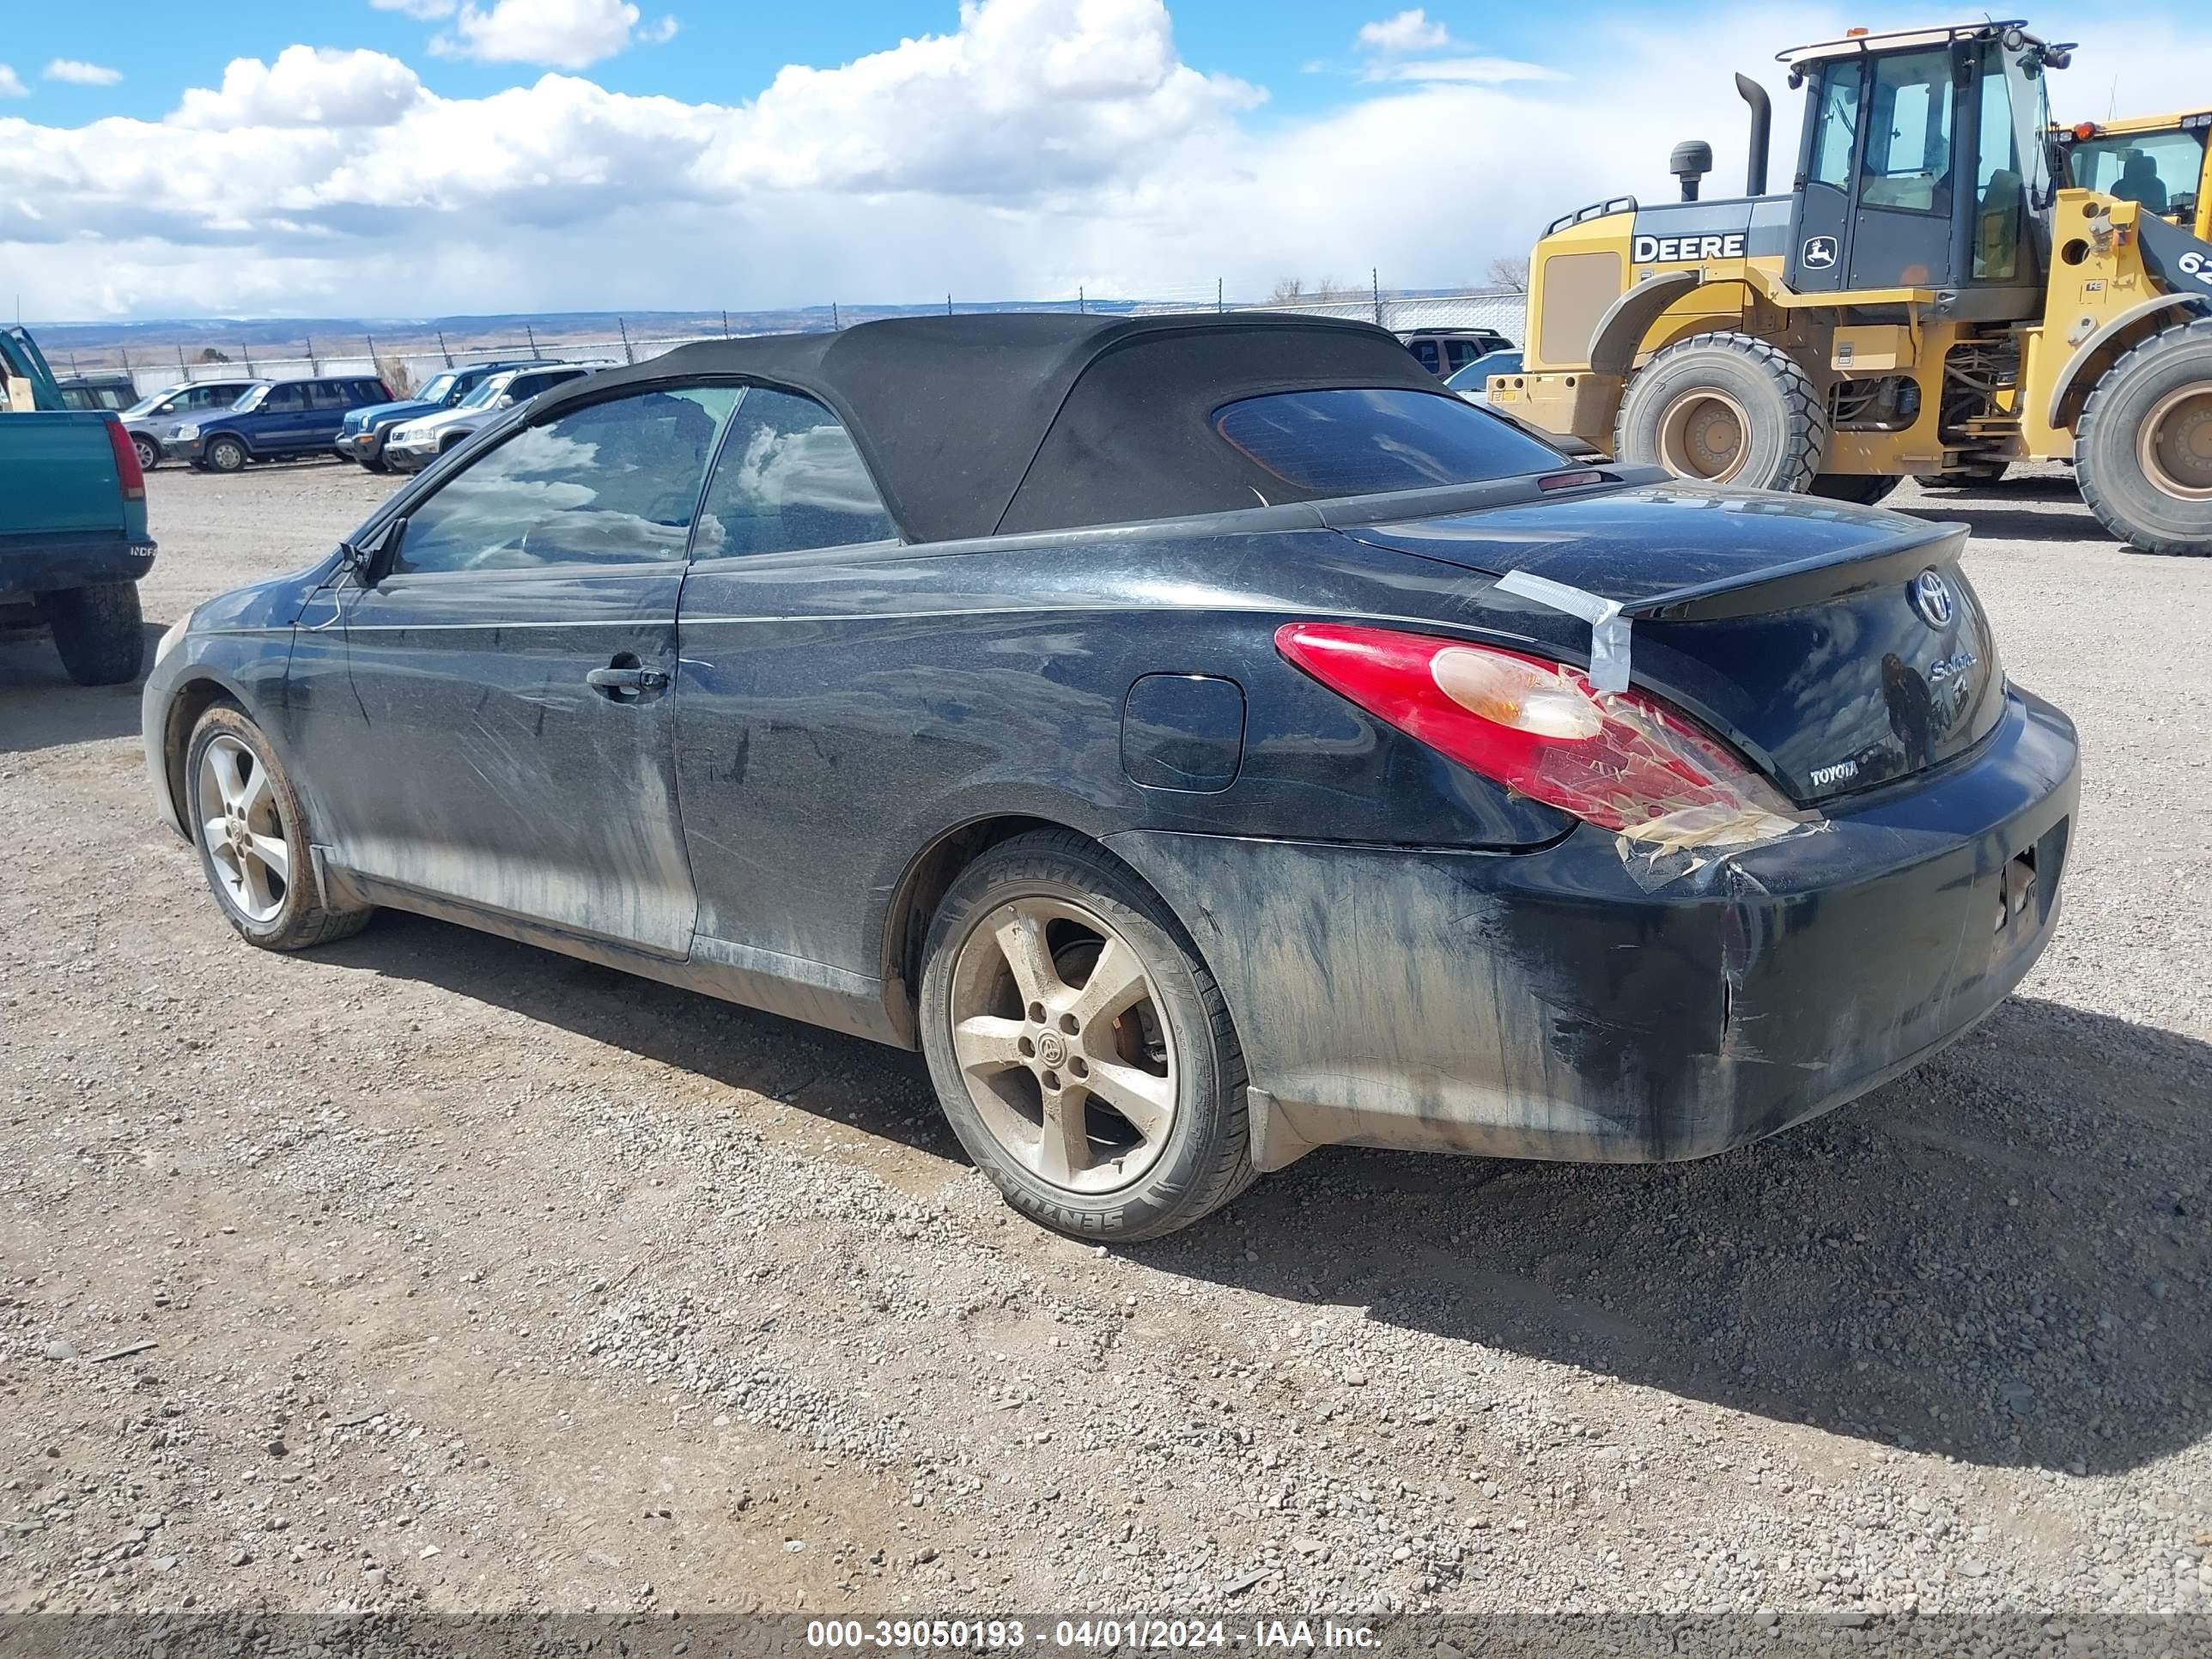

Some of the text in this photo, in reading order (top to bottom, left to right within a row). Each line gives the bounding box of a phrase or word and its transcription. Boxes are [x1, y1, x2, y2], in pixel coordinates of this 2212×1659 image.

[1633, 234, 1745, 264] DEERE
[1810, 760, 1860, 787] TOYOTA
[976, 1157, 1124, 1231] SENTURY
